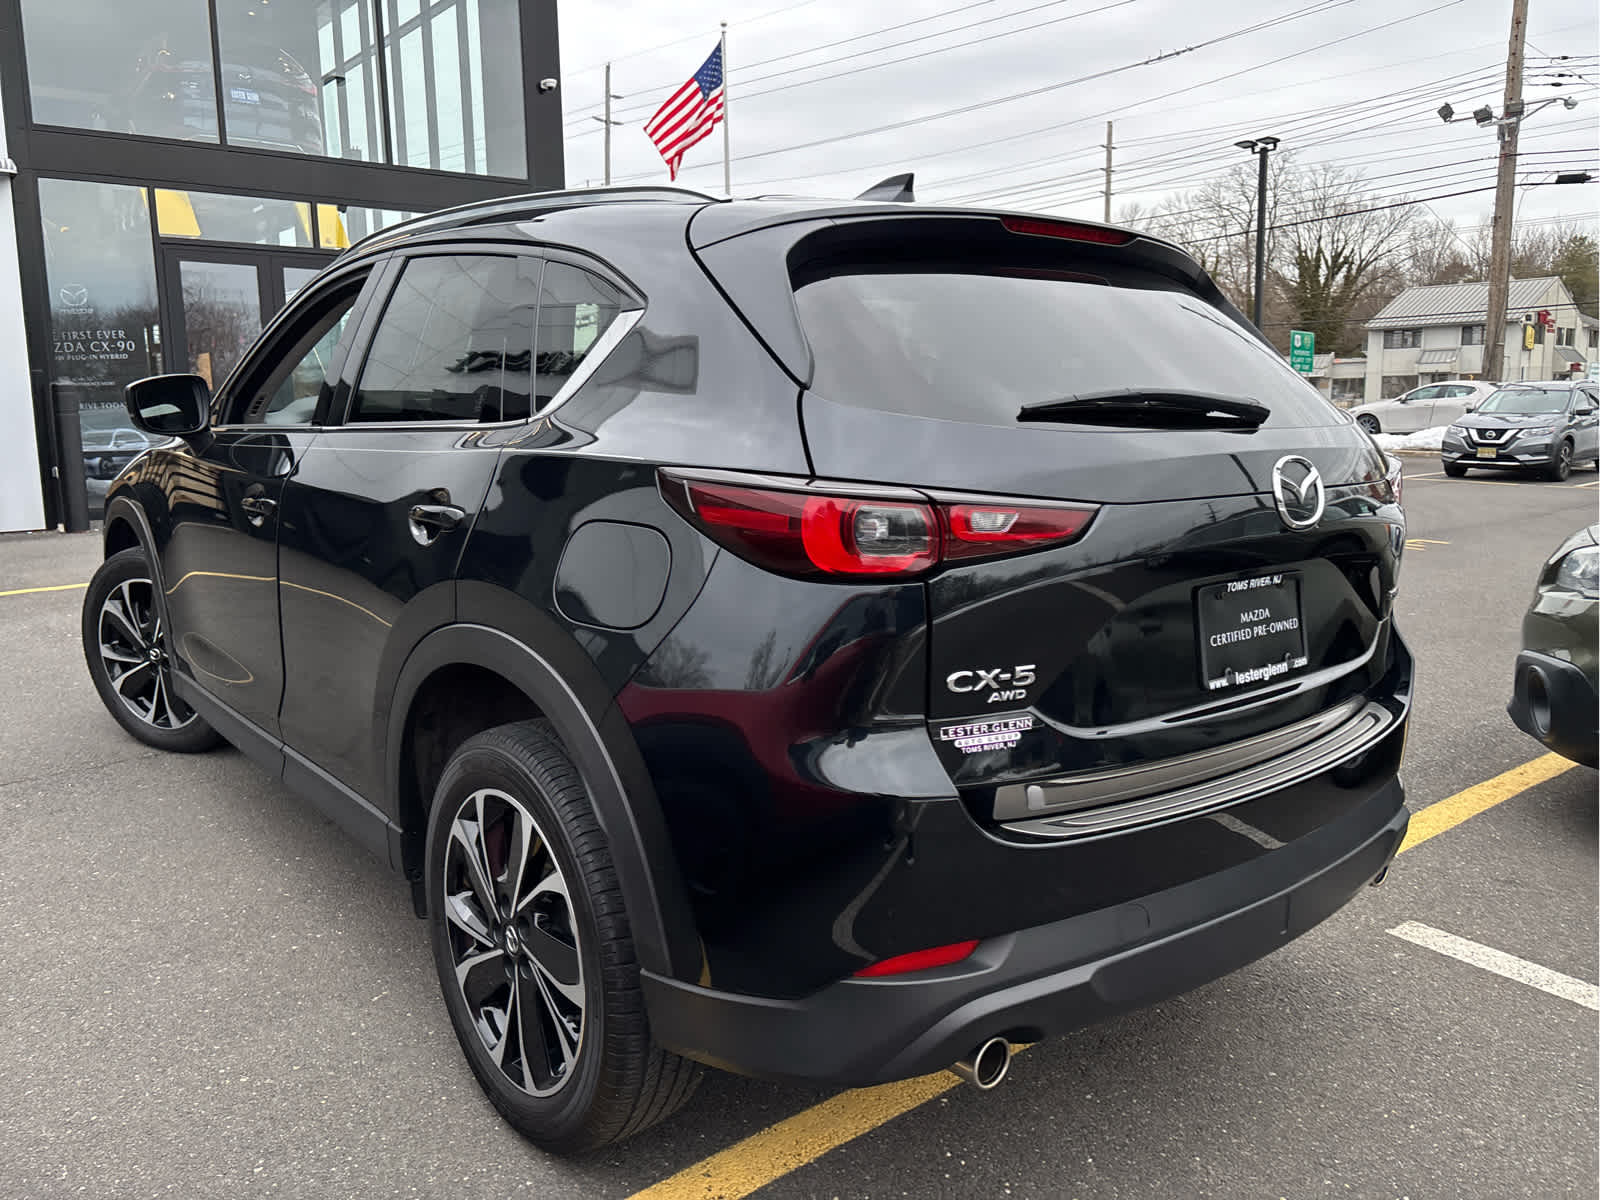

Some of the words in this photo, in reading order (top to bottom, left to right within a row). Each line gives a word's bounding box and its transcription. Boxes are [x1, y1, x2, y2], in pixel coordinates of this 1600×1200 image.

[62, 330, 92, 340] FIRST
[96, 329, 127, 340] EVER
[54, 341, 86, 353] ZDA
[90, 340, 136, 353] CX-90
[100, 401, 128, 410] TODA
[1226, 579, 1249, 592] TOMS
[1272, 574, 1283, 584] NJ
[1240, 608, 1271, 624] MAZDA
[1210, 627, 1252, 647] CERTIFIED
[1253, 617, 1299, 638] PRE-OWNED
[946, 664, 1036, 693] CX-5
[1235, 662, 1289, 685] lesterglenn
[987, 689, 1027, 703] AWD
[940, 725, 989, 738] LESTER
[992, 719, 1033, 732] GLENN
[960, 745, 983, 754] TOMS
[1007, 740, 1017, 748] NJ
